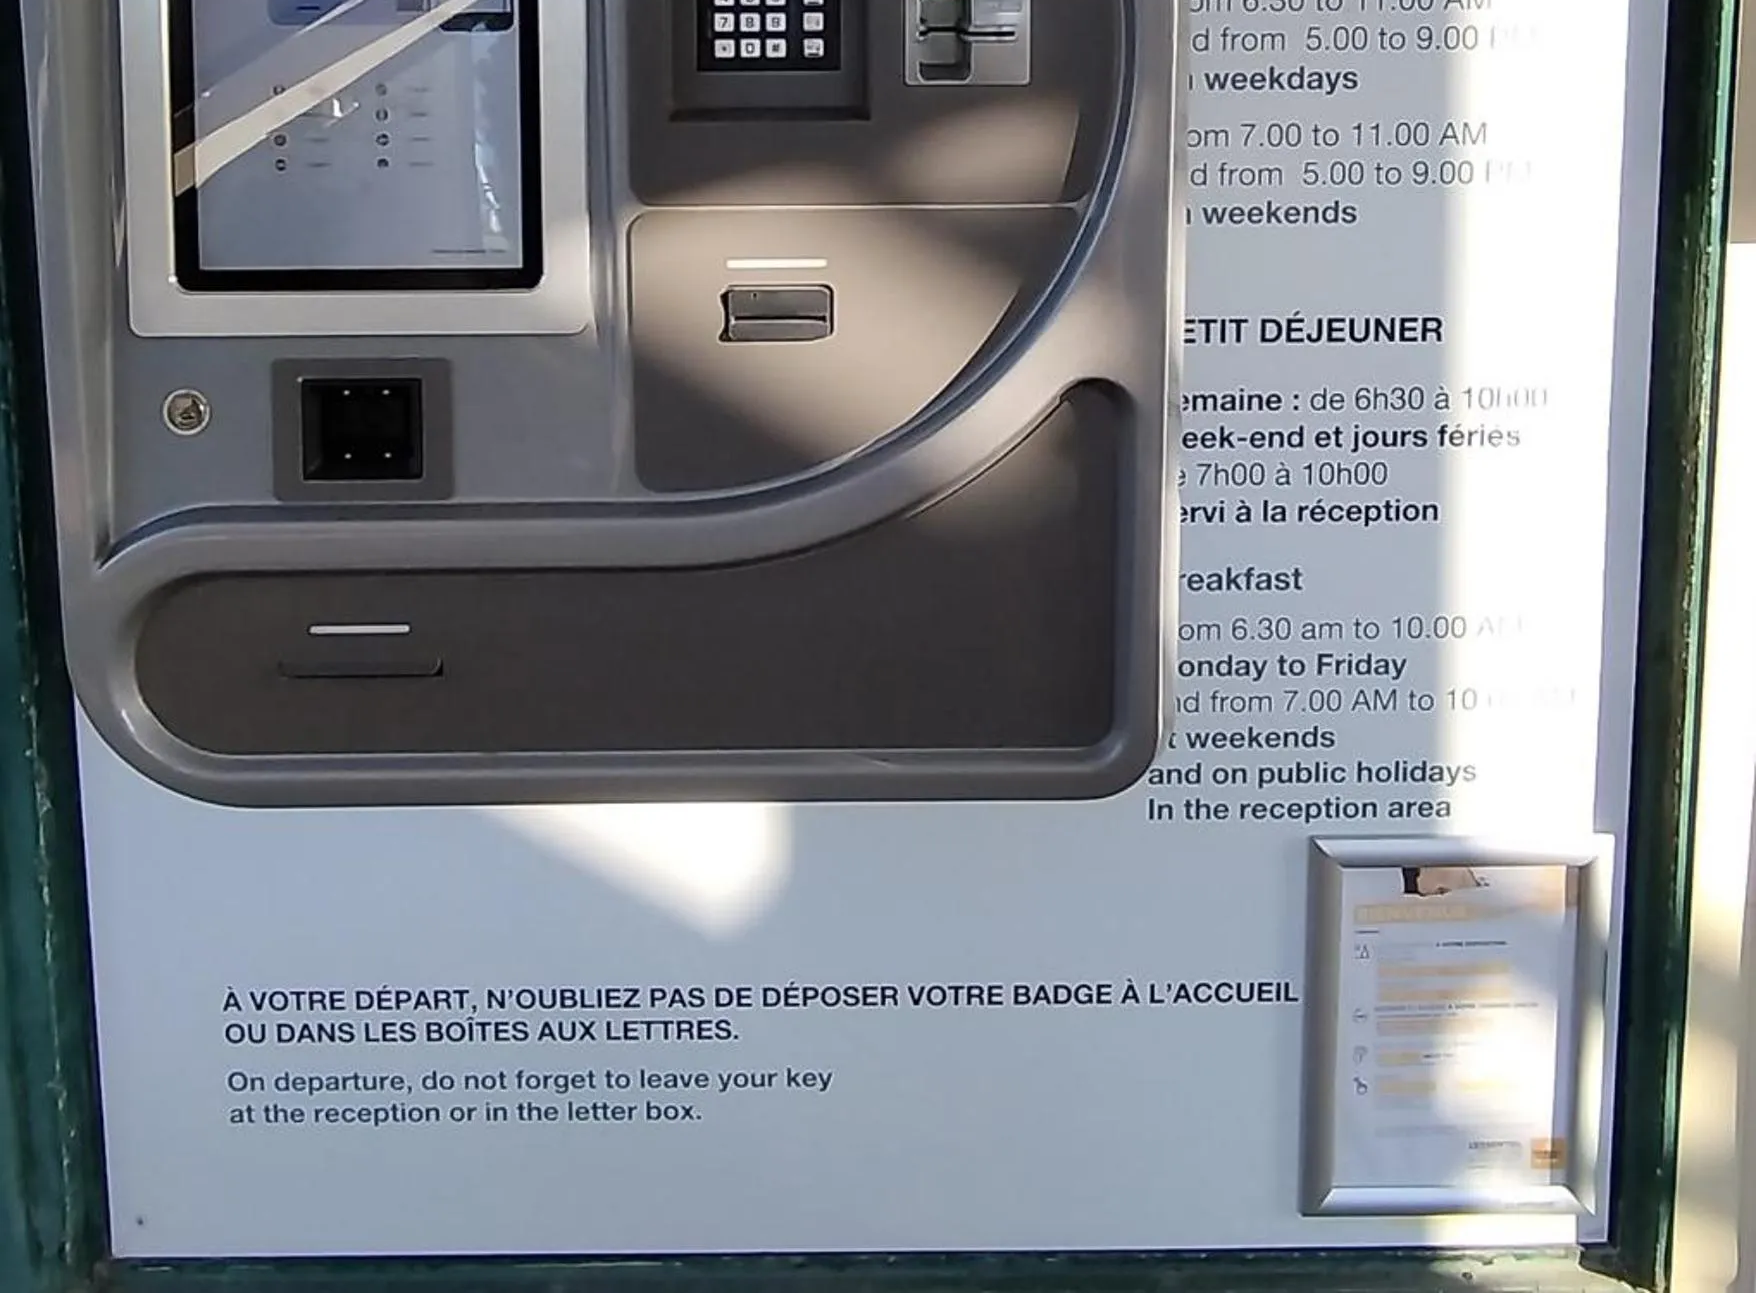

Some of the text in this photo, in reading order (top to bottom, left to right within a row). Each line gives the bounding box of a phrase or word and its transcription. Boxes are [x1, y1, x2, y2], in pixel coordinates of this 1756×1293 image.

[1220, 26, 1285, 52] from
[1306, 26, 1368, 52] 5.00
[1378, 27, 1406, 51] to
[1417, 25, 1478, 49] 9.00
[1204, 65, 1358, 96] weekdays
[1187, 122, 1487, 148] om 7.00 to 11.00 AM
[1218, 161, 1283, 187] from
[1302, 160, 1364, 186] 5.00
[1374, 162, 1402, 186] to
[1413, 160, 1473, 184] 9.00
[1201, 200, 1357, 225] weekends
[1183, 310, 1443, 344] ETIT DÉJEUNER
[1182, 388, 1283, 412] maine
[1293, 393, 1300, 411] :
[1309, 387, 1345, 412] de
[1354, 386, 1425, 411] 6h30
[1435, 387, 1450, 409] à
[1181, 425, 1304, 449] eek-end
[1314, 426, 1343, 448] et
[1350, 424, 1428, 453] jours
[1177, 461, 1388, 487] e 7h00 à 10h00
[1180, 498, 1438, 527] ervi à la réception
[1179, 567, 1303, 592] eakfast
[1178, 622, 1220, 641] om
[1231, 617, 1292, 641] 6.30
[1300, 622, 1343, 641] am
[1353, 617, 1380, 640] to
[1392, 616, 1466, 639] 10.00
[1178, 653, 1407, 682] onday to Friday
[1210, 689, 1273, 713] from
[1283, 689, 1342, 713] 7.00
[1351, 688, 1397, 712] AM
[1408, 689, 1435, 712] to
[1185, 725, 1335, 749] weekends
[1148, 760, 1476, 789] and on public holidays
[1148, 796, 1451, 824] In the reception area
[223, 986, 242, 1012] À
[249, 990, 346, 1012] VOTRE
[355, 984, 477, 1013] DÉPART,
[650, 987, 706, 1008] PAS
[714, 987, 753, 1008] DE
[762, 981, 899, 1008] DÉPOSER
[907, 985, 1004, 1006] VOTRE
[1013, 983, 1112, 1005] BADGE
[1121, 978, 1140, 1004] À
[225, 1016, 739, 1044] OU DANS LES BOÎTES AUX LETTRES.
[227, 1067, 833, 1096] On departure, do not forget to leave your key
[230, 1100, 702, 1127] at the reception or in the letter box.
